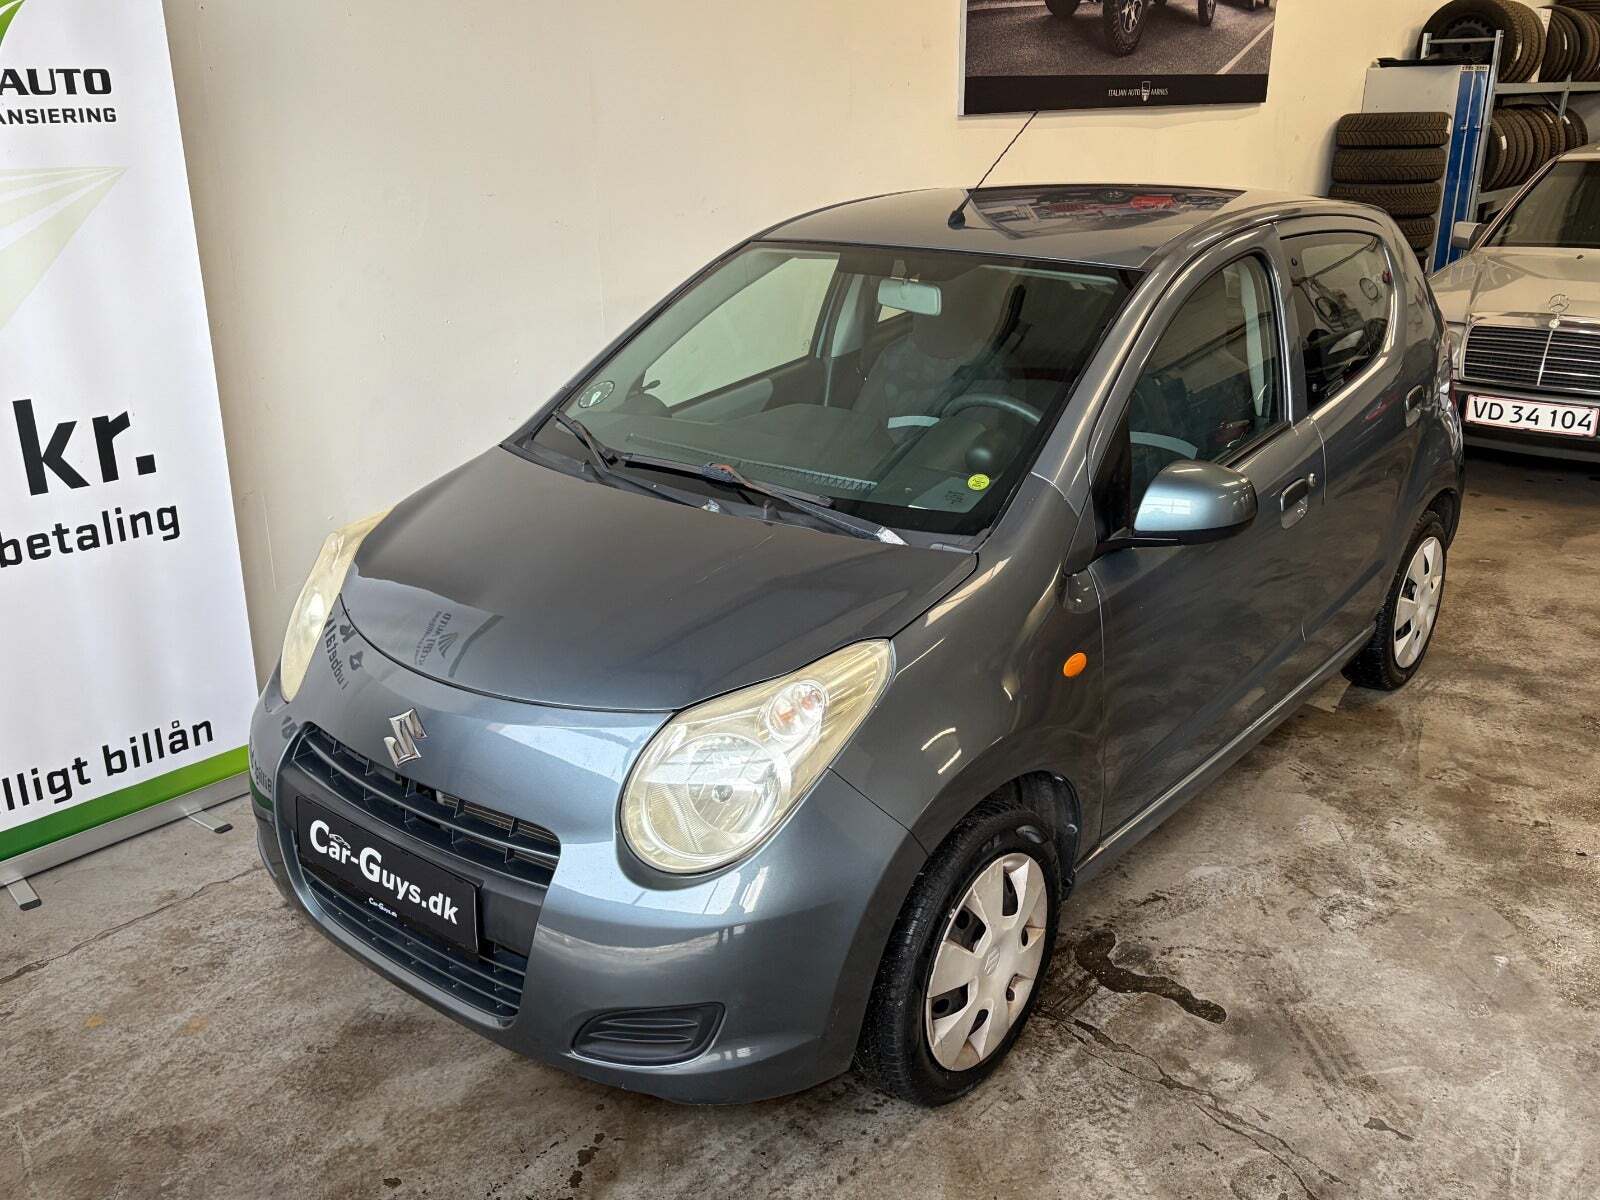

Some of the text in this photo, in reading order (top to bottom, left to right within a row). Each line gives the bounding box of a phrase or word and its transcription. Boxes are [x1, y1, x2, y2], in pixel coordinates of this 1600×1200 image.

[0, 68, 112, 96] AUTO
[12, 398, 157, 496] kr.
[1473, 400, 1592, 431] VD 34 104
[0, 505, 181, 568] betaling
[0, 757, 92, 812] lligt
[102, 720, 214, 777] billån
[309, 819, 459, 926] Car-Guys.dk
